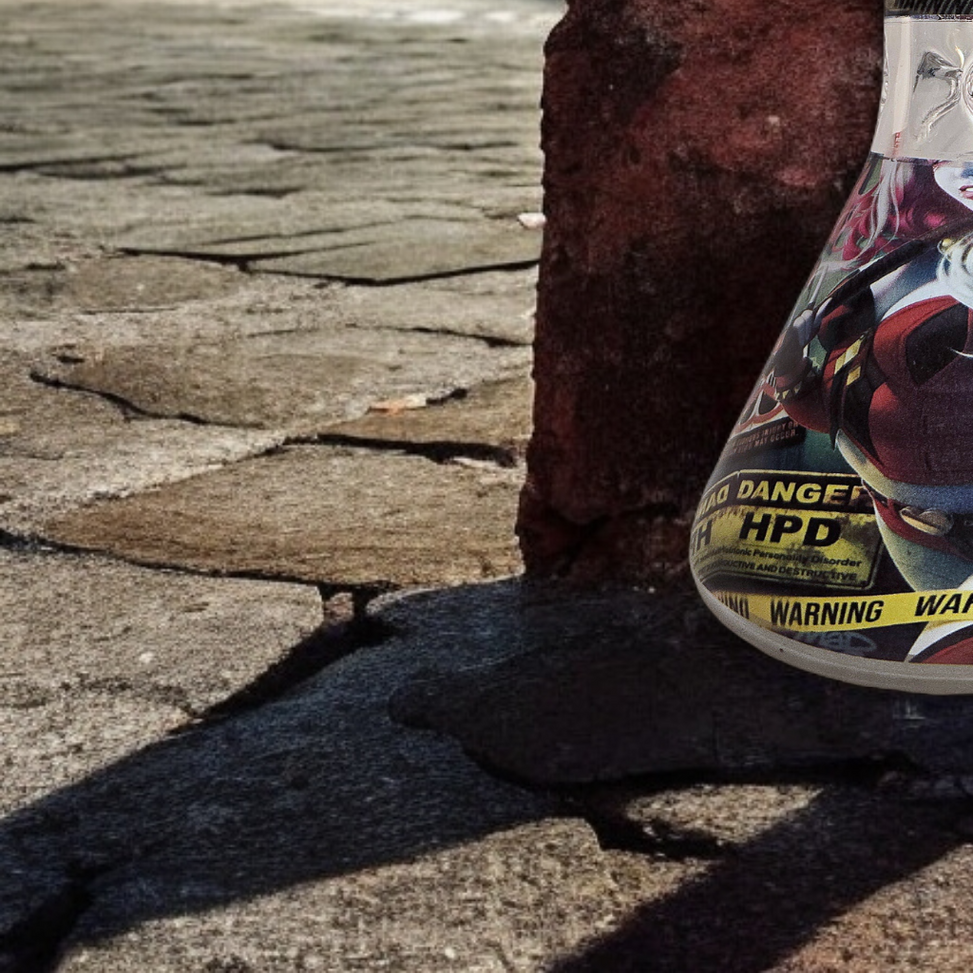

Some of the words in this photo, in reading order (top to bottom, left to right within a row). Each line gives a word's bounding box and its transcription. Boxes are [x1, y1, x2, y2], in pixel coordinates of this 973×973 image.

[738, 511, 842, 547] HPD
[756, 562, 778, 573] AND
[778, 565, 858, 581] DESTRUCTIVE
[811, 556, 863, 568] Disorder
[770, 595, 885, 627] WARNING
